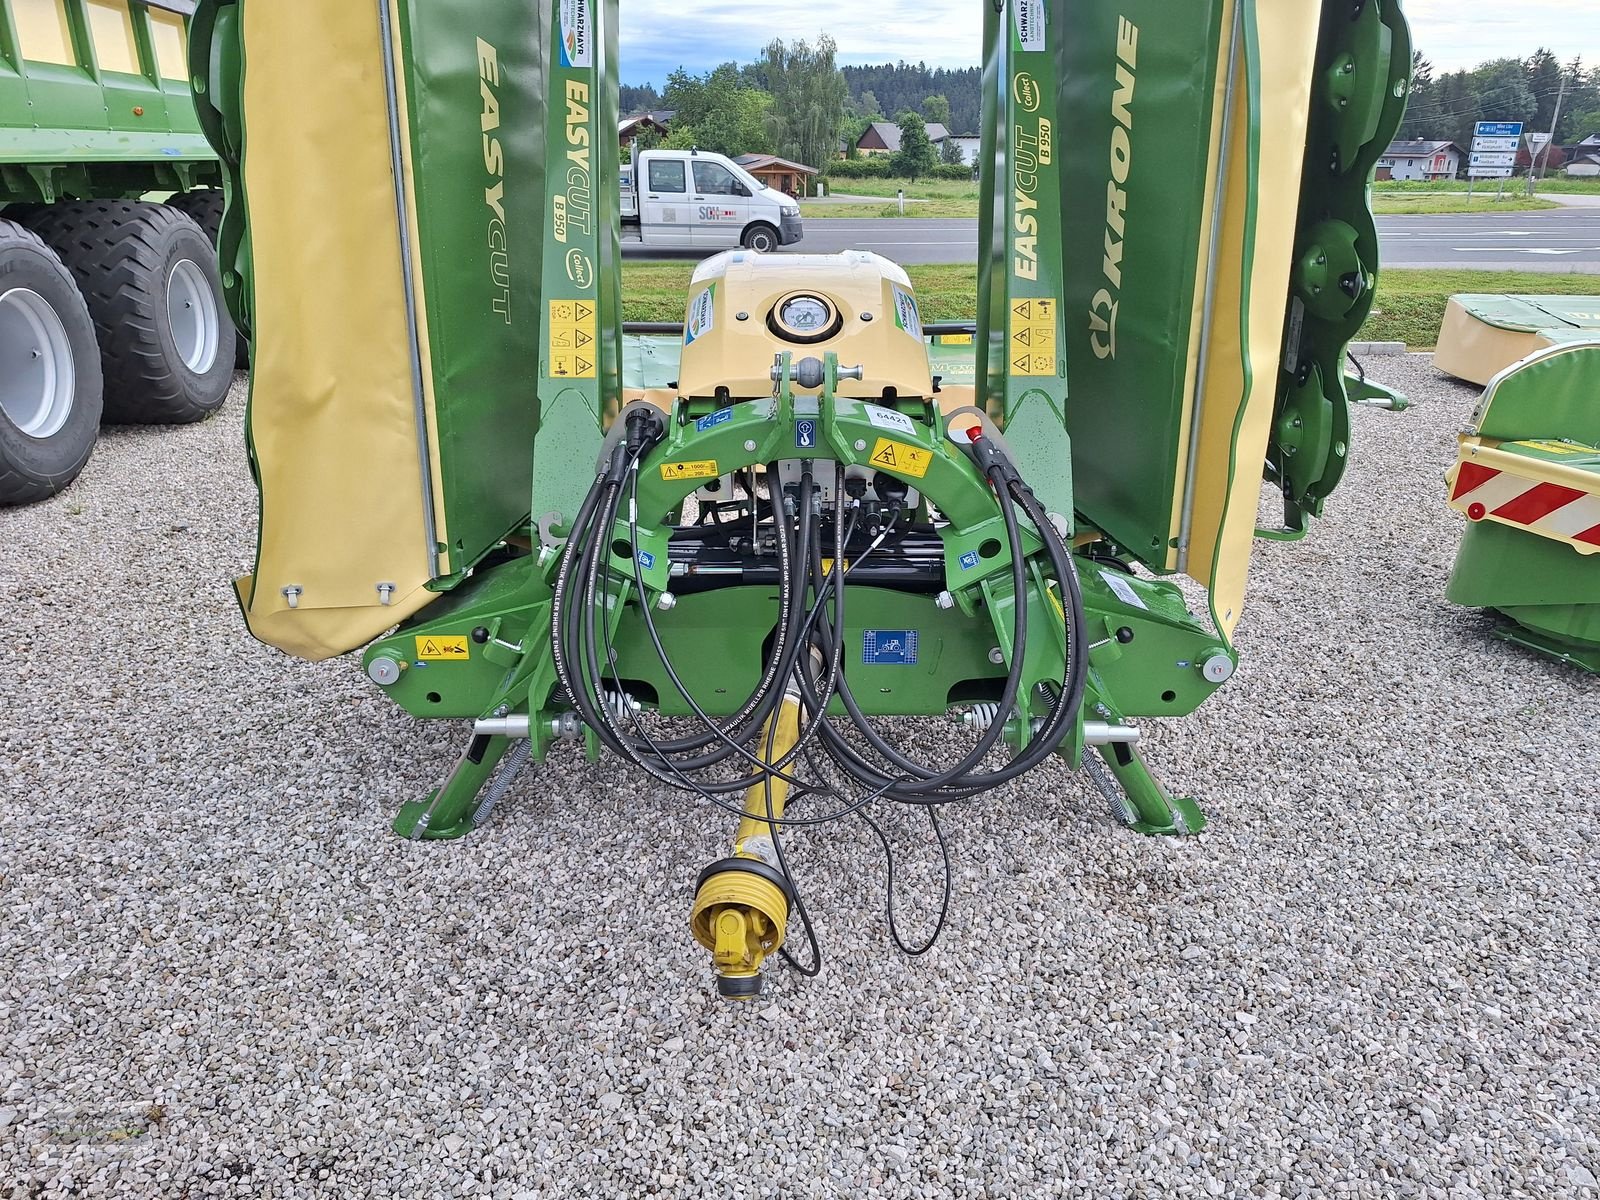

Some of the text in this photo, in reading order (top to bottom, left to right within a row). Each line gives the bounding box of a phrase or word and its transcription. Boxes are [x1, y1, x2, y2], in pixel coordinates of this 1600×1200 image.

[1021, 77, 1033, 107] Collect
[566, 79, 590, 235] EASYCUT
[1040, 124, 1050, 158] B 950
[1103, 14, 1139, 290] KRONE
[476, 36, 511, 324] EASYCUT
[555, 201, 565, 236] B 950
[1014, 125, 1038, 281] EASYCUT
[573, 254, 585, 283] Collect
[876, 412, 908, 425] 64421
[559, 542, 574, 579] HYDRAULIK
[554, 579, 564, 611] MUELLER
[744, 689, 766, 715] MUELLER
[761, 666, 777, 690] RHEINE
[781, 543, 789, 558] BAR
